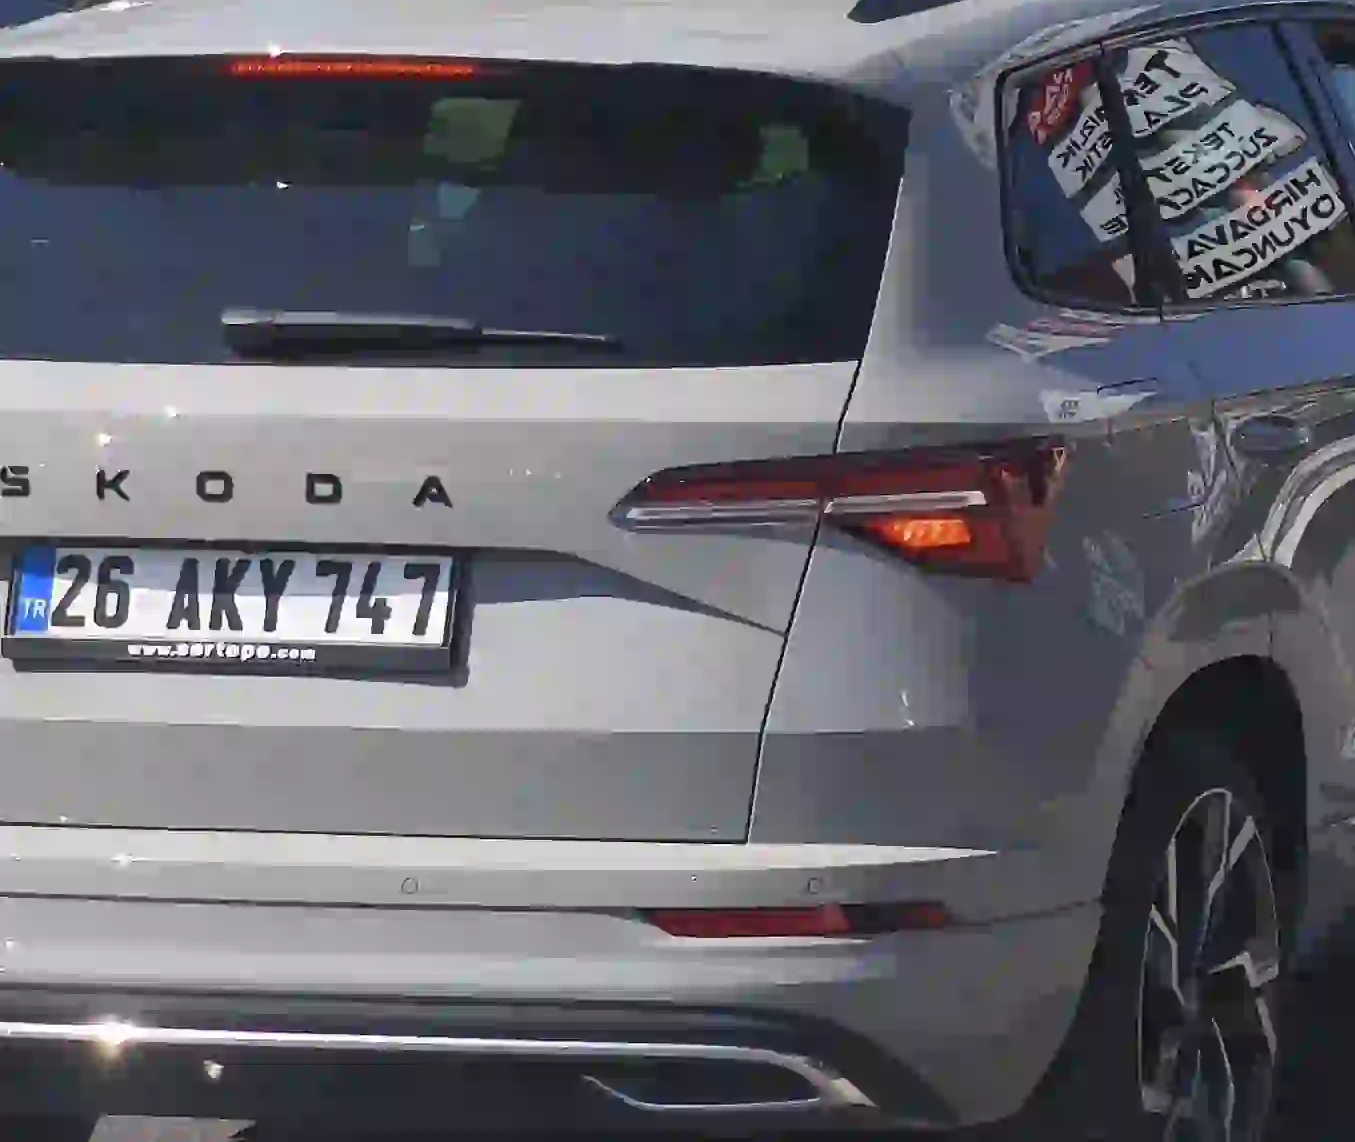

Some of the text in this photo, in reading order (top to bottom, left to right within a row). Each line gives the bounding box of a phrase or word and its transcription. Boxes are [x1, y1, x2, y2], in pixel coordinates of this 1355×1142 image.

[51, 553, 135, 628] 26
[166, 556, 295, 633] AKY
[314, 560, 442, 637] 747
